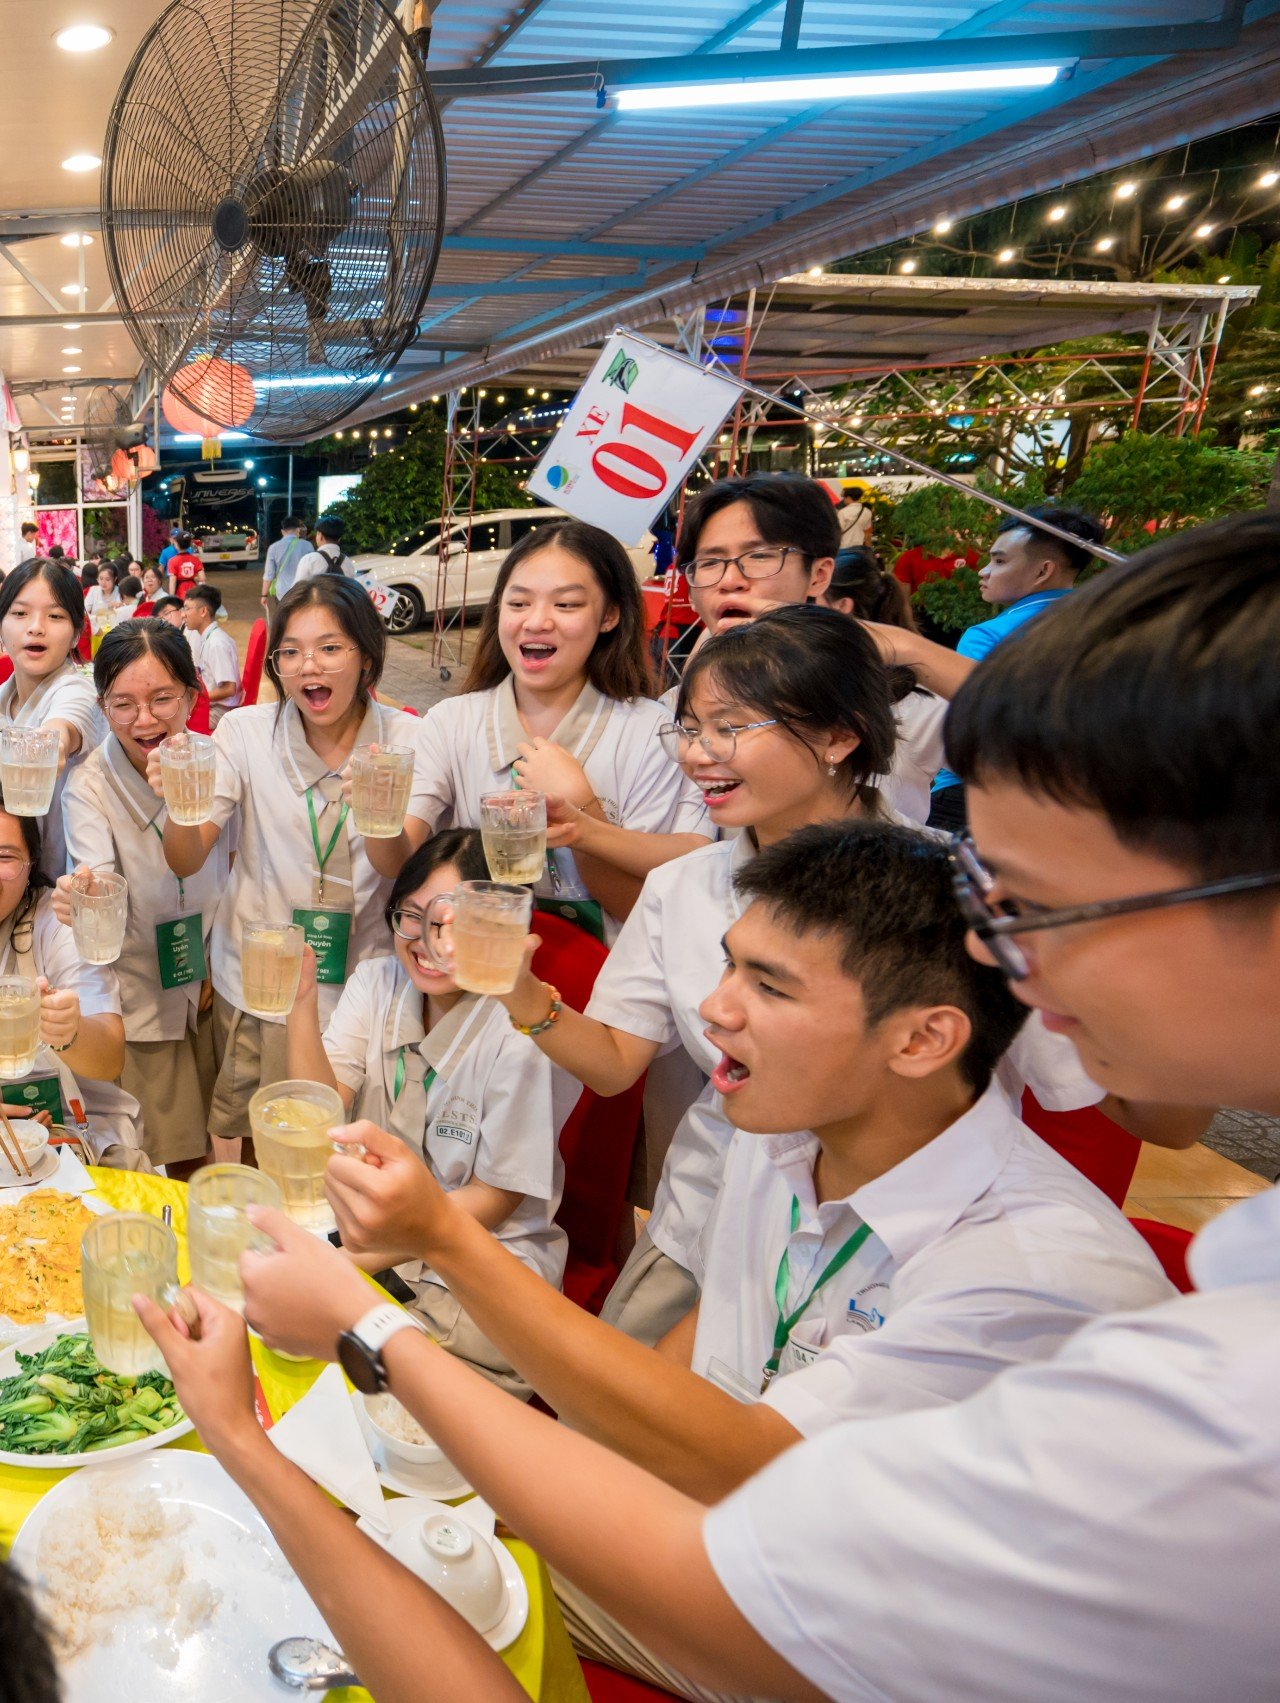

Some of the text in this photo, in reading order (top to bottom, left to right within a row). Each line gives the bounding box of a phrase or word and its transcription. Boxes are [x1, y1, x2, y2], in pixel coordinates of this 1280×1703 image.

[575, 405, 610, 446] XE
[592, 401, 705, 500] 01
[442, 1110, 477, 1125] LSTS
